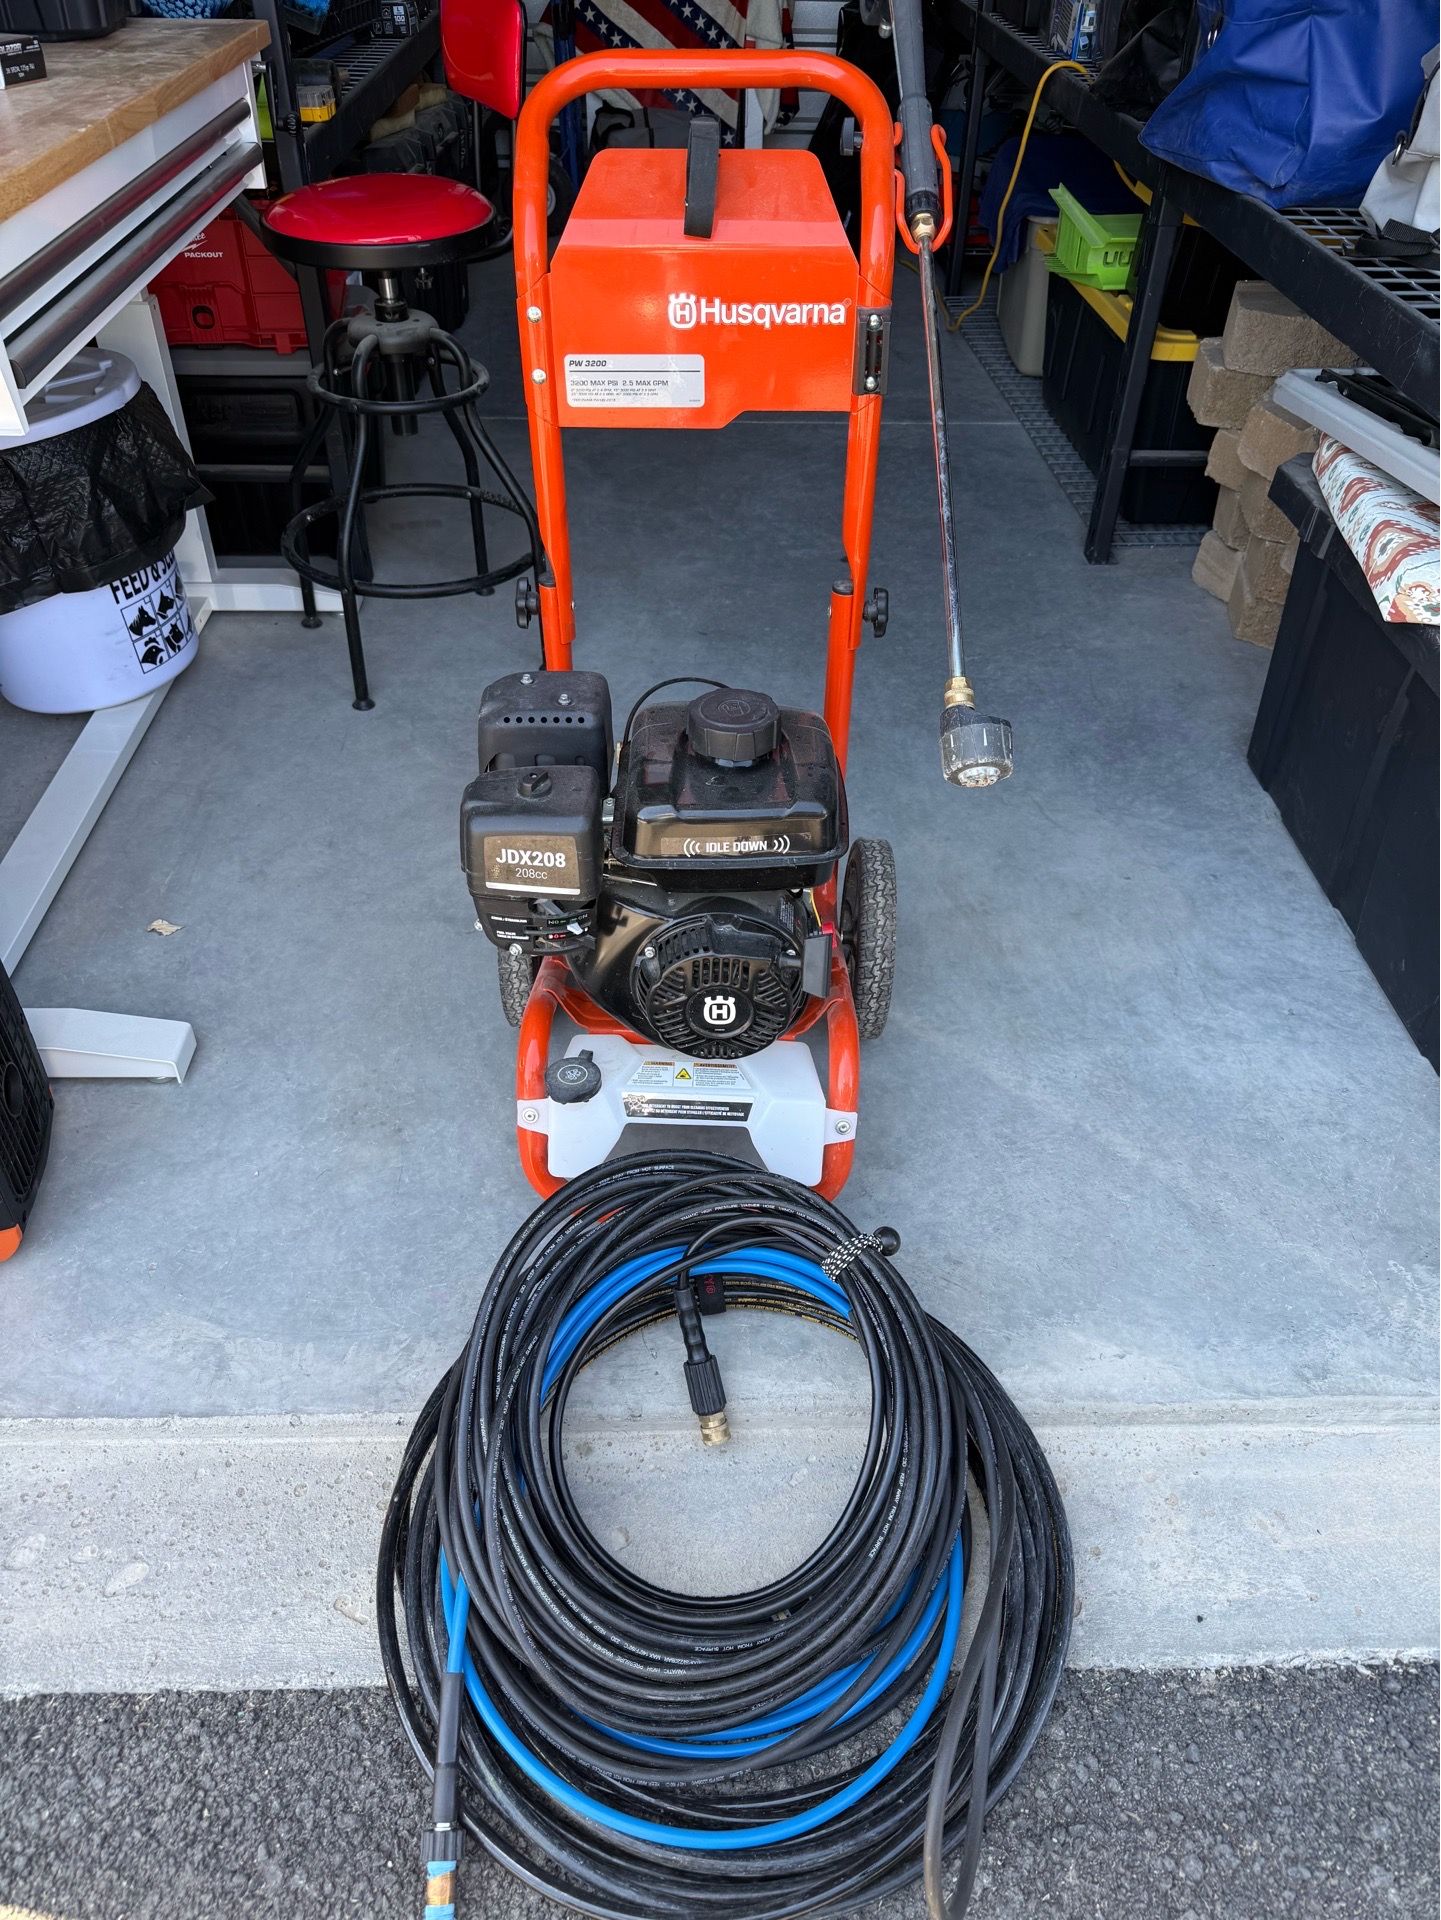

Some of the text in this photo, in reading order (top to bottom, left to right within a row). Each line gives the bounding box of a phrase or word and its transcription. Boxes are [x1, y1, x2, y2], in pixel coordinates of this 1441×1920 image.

[109, 568, 150, 604] FEED
[706, 840, 768, 852] IDLE DOWN
[496, 848, 566, 868] JDX208
[515, 868, 548, 880] 208cc
[544, 1244, 555, 1256] FROM
[565, 1218, 583, 1234] SURFACE
[513, 1240, 522, 1253] FROM
[868, 1536, 884, 1558] SURFACE
[541, 1564, 557, 1586] SURFACE
[557, 1588, 566, 1598] HOT
[567, 1598, 579, 1612] FROM
[580, 1613, 593, 1624] AWAY
[579, 1631, 592, 1643] HOSE
[593, 1625, 606, 1635] KEEP
[592, 1642, 614, 1658] WASHER
[616, 1656, 644, 1670] PRESSURE
